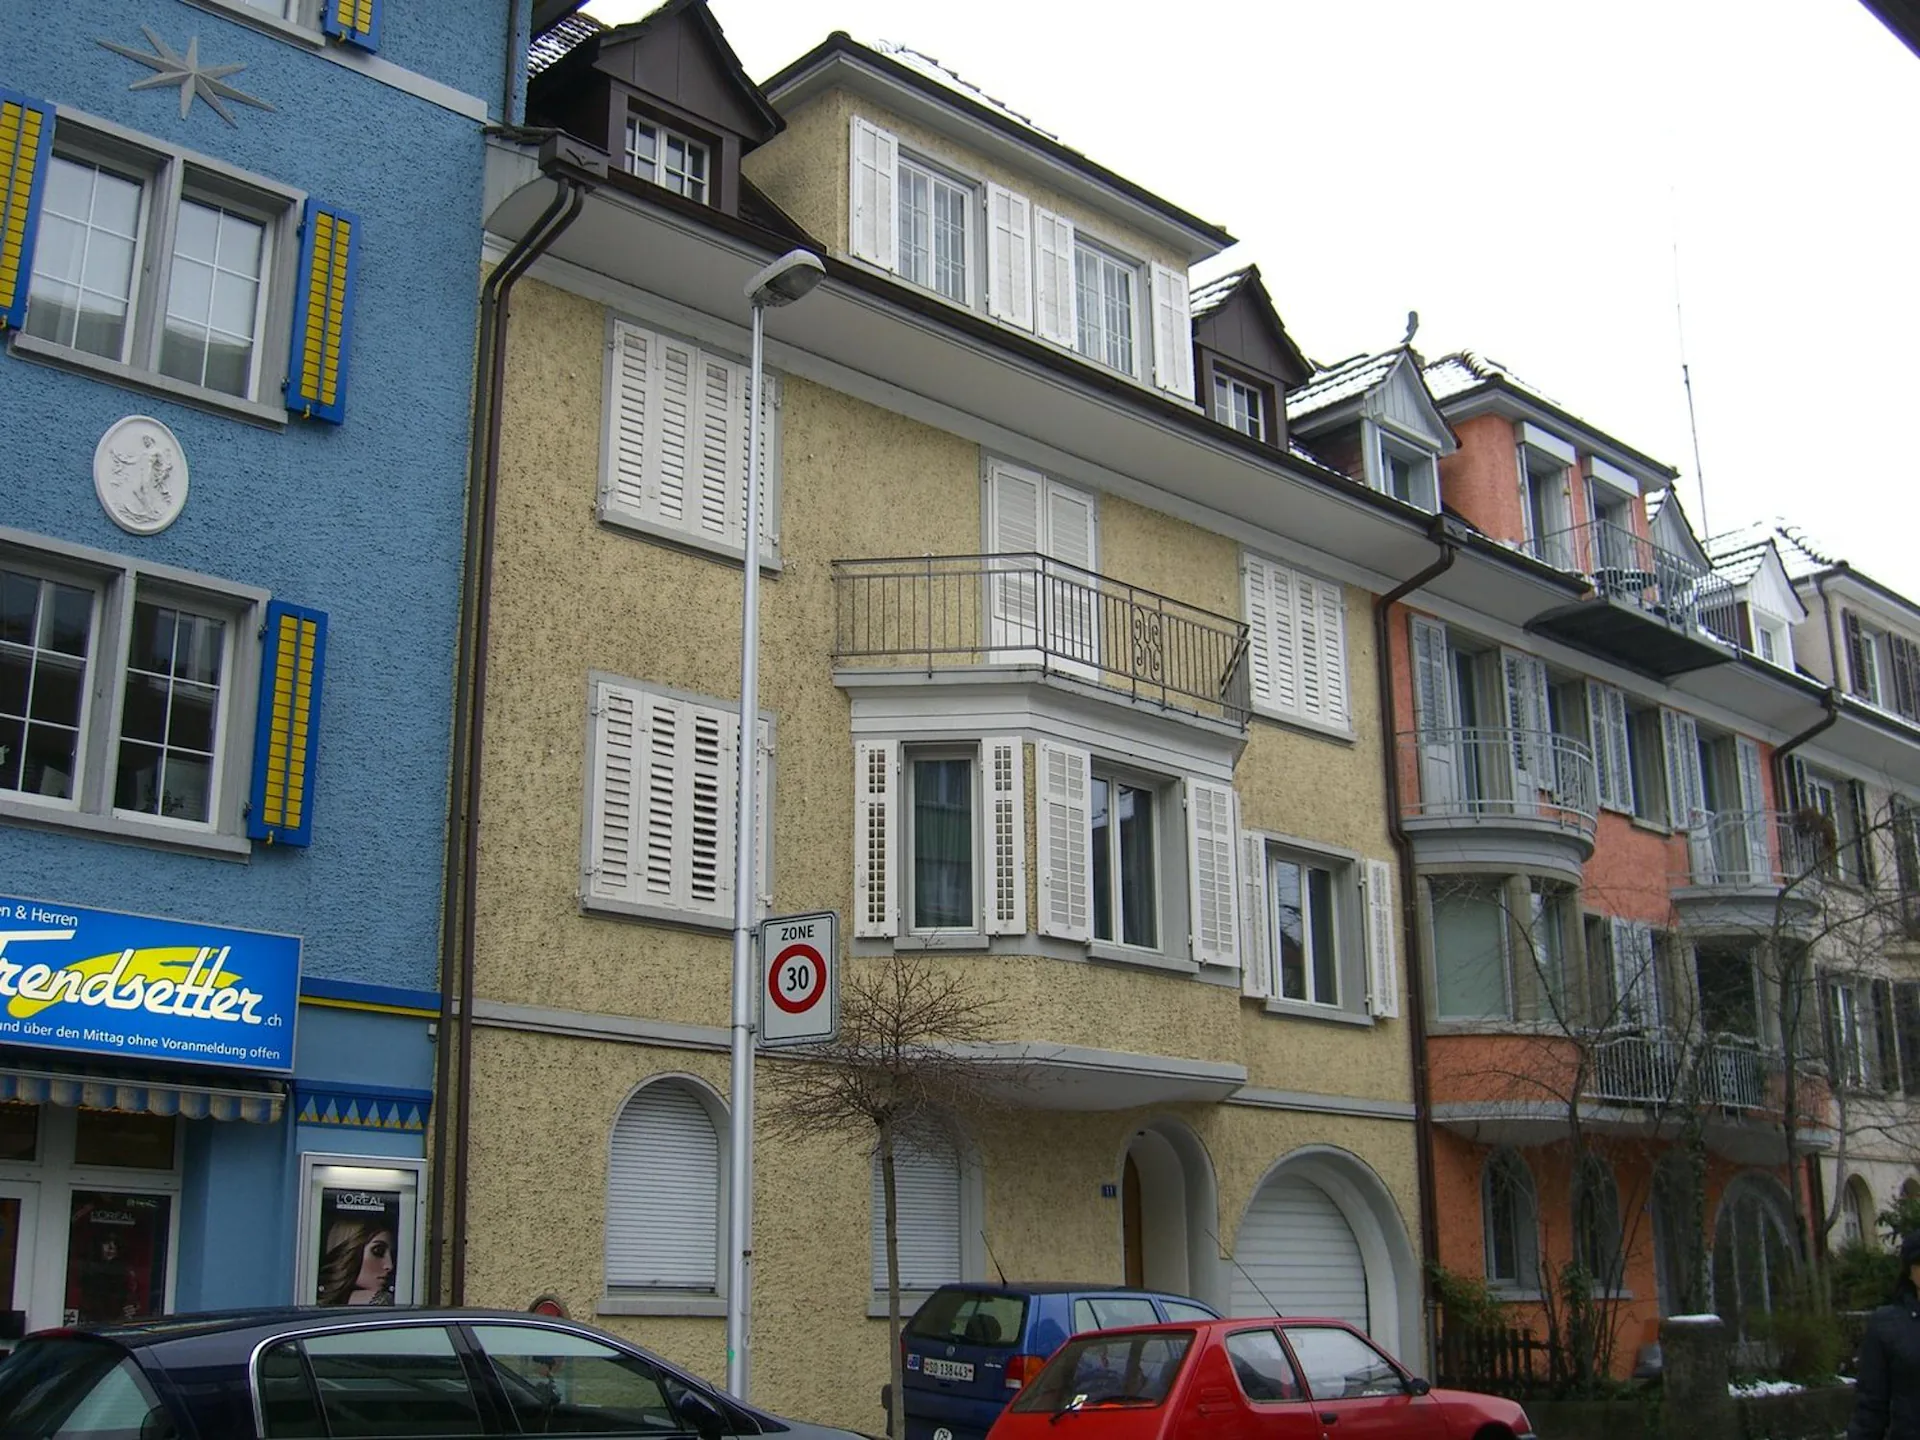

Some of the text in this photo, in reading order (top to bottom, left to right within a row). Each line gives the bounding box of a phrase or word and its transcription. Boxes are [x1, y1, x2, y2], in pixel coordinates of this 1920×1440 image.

[15, 905, 27, 920] &
[31, 907, 78, 927] Herren
[781, 924, 815, 941] ZONE
[786, 965, 810, 992] 30
[24, 1021, 53, 1036] über
[56, 1025, 80, 1039] den
[83, 1028, 124, 1046] Mittag
[127, 1032, 158, 1047] ohne
[161, 1036, 247, 1059] Voranmeldung
[249, 1044, 280, 1060] offen
